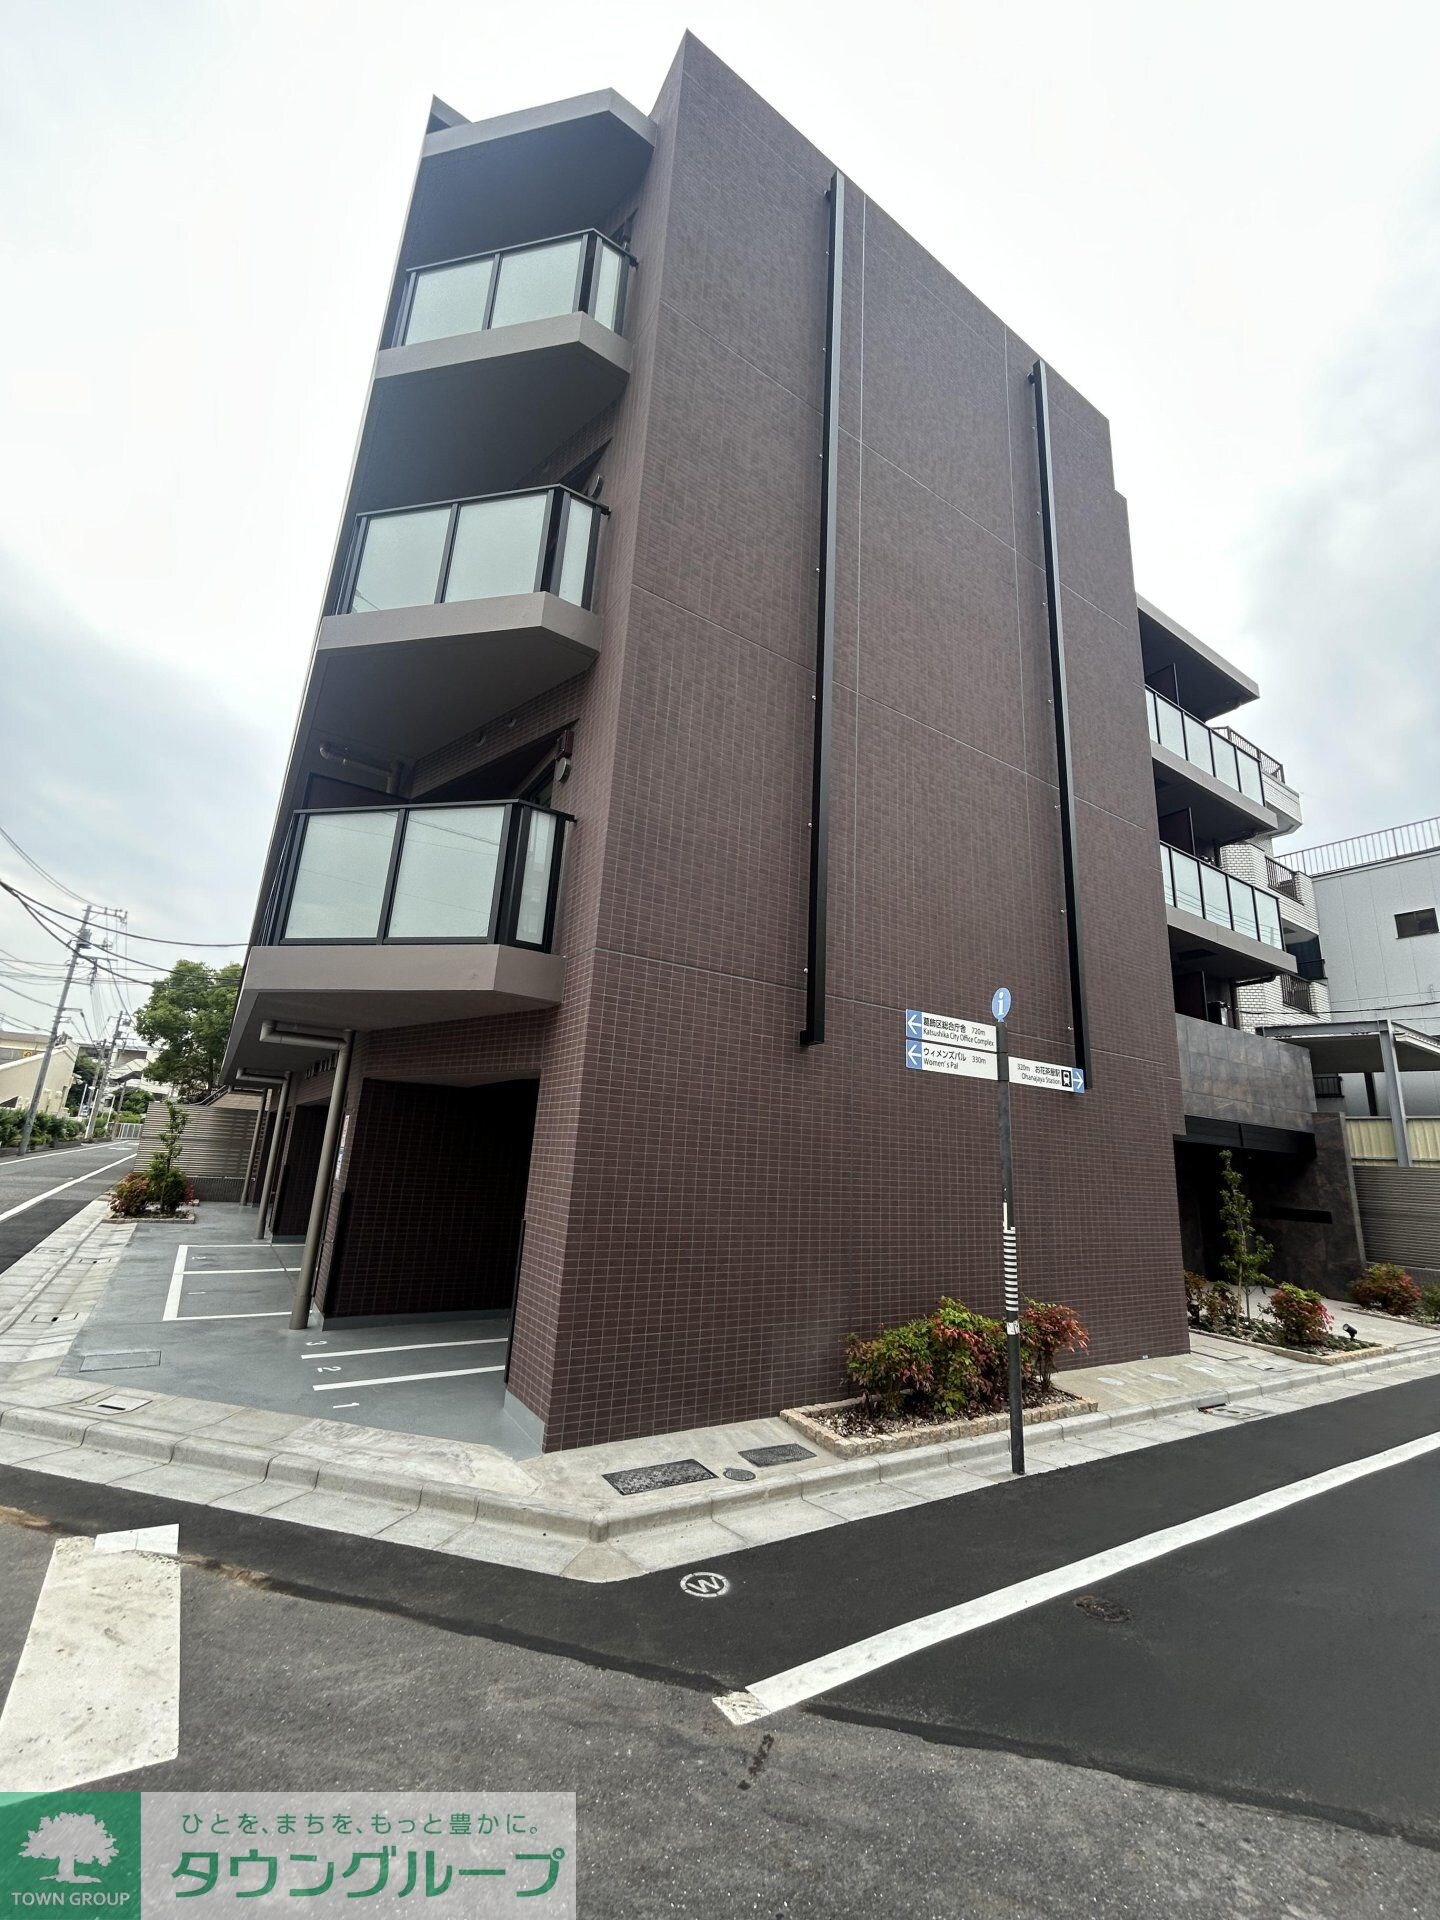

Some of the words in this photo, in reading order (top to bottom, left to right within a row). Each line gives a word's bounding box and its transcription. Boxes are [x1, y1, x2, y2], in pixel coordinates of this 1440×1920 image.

[923, 1016, 967, 1034] 葛飾区総合庁舎
[971, 1026, 986, 1036] 720m
[923, 1027, 949, 1039] Katsushika
[949, 1032, 960, 1042] City
[960, 1034, 974, 1044] Office
[973, 1036, 995, 1047] Complex
[923, 1047, 967, 1062] ウィメンズパル
[971, 1055, 987, 1065] 330m
[950, 1062, 959, 1070] Pal
